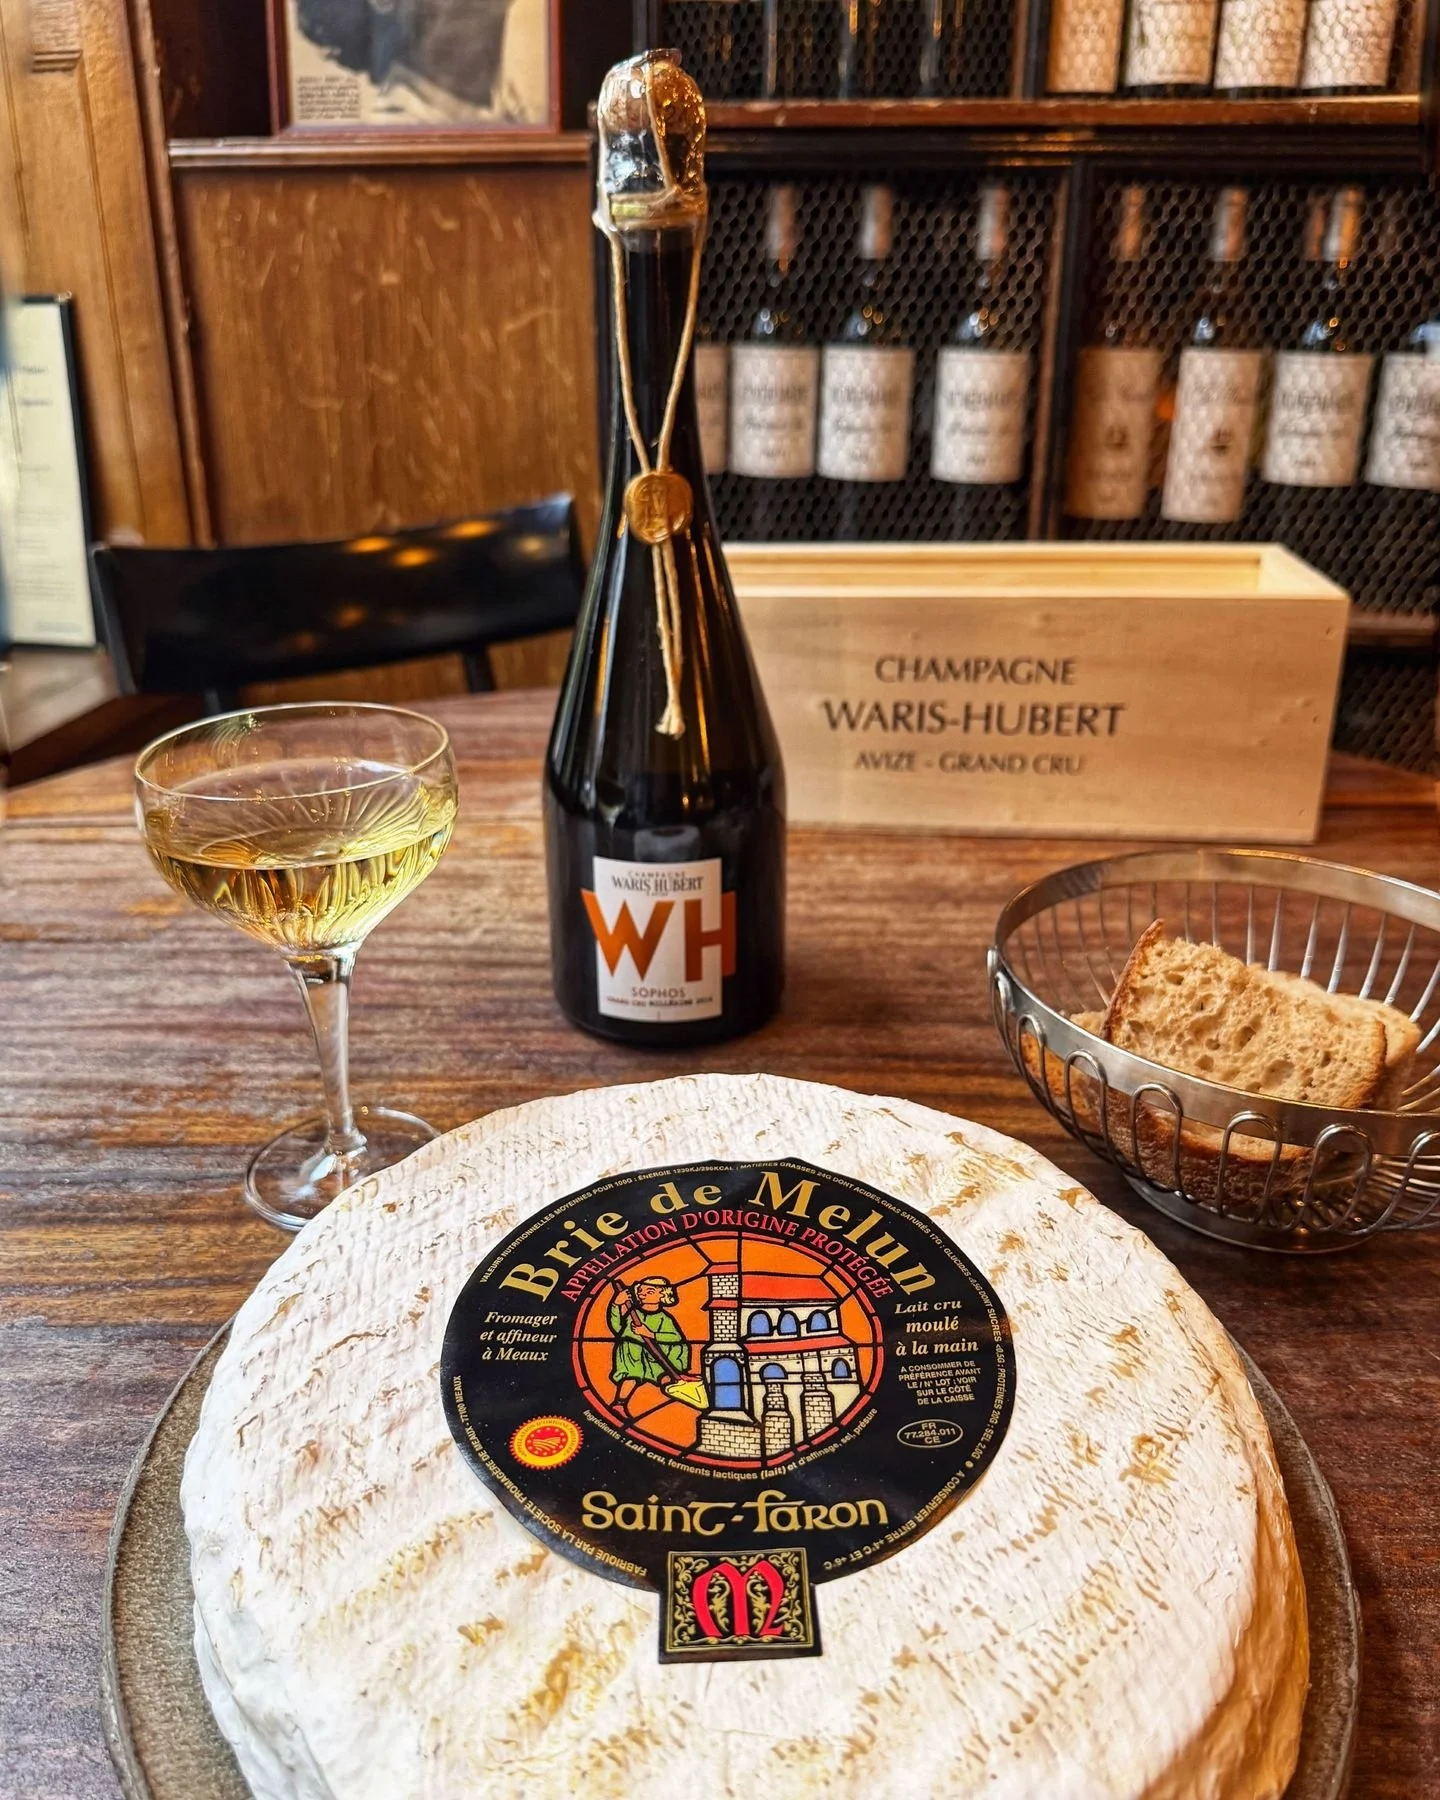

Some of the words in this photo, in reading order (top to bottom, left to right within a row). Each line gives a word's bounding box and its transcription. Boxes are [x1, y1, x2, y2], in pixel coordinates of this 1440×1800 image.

[874, 655, 1078, 686] CHAMPAGNE
[822, 699, 1128, 737] WARIS-HUBERT
[853, 751, 915, 773] AVIZE
[938, 752, 1027, 774] GRAND
[1032, 754, 1083, 776] CRU
[611, 876, 651, 892] WARIS
[654, 876, 703, 892] HUBERT
[631, 986, 686, 998] SOPHOS
[780, 1161, 816, 1175] GRASSES
[816, 1171, 831, 1180] 24G
[592, 1183, 614, 1195] POUR
[614, 1178, 633, 1188] 100G
[832, 1177, 854, 1189] DONT
[553, 1192, 592, 1215] MOYENNES
[881, 1200, 901, 1214] GRAS
[900, 1211, 931, 1234] SATURÉS
[499, 1211, 629, 1302] Brie
[650, 1181, 723, 1214] de
[748, 1171, 936, 1296] Melun
[501, 1213, 555, 1257] NUTRITIONNELLES
[929, 1233, 942, 1245] 17G
[560, 1217, 678, 1302] APPELLATION
[681, 1209, 800, 1236] D'ORIGINE
[800, 1226, 894, 1299] PROTÉGÉE
[943, 1248, 972, 1277] GLUCIDES
[480, 1256, 504, 1282] VALEURS
[895, 1301, 929, 1314] Lait
[934, 1300, 962, 1311] cru
[978, 1290, 994, 1307] DONT
[484, 1311, 558, 1328] Fromager
[906, 1315, 959, 1333] moulé
[988, 1308, 1002, 1342] SUCRES
[480, 1330, 495, 1340] et
[496, 1329, 557, 1344] affineur
[481, 1346, 493, 1360] à
[495, 1347, 549, 1361] Meaux
[895, 1341, 907, 1356] à
[912, 1341, 929, 1355] la
[934, 1338, 979, 1354] main
[898, 1369, 954, 1381] PRÉFÉRENCE
[955, 1367, 982, 1376] AVANT
[901, 1365, 908, 1373] A
[908, 1361, 963, 1372] CONSOMMER
[453, 1375, 464, 1403] MEAUX
[935, 1378, 951, 1386] LOT
[956, 1376, 977, 1384] VOIR
[916, 1388, 934, 1397] SUR
[936, 1387, 948, 1395] LE
[948, 1384, 972, 1394] CÔTÉ
[931, 1396, 943, 1404] LA
[944, 1393, 976, 1403] CAISSE
[457, 1403, 470, 1422] 77100
[904, 1428, 957, 1439] 77.284.011
[921, 1422, 937, 1430] FR
[981, 1427, 994, 1442] SEL
[465, 1425, 483, 1452] MEAUX
[583, 1409, 621, 1440] Ingrédients
[625, 1440, 647, 1454] Lait
[646, 1452, 666, 1465] cru,
[667, 1458, 711, 1476] ferments
[712, 1469, 758, 1481] lactiques
[760, 1466, 787, 1480] (lait)
[787, 1462, 798, 1471] et
[798, 1443, 843, 1466] d'affinage,
[841, 1432, 856, 1444] sel,
[853, 1408, 878, 1434] présure
[924, 1436, 940, 1444] CE
[478, 1449, 490, 1462] DE
[485, 1459, 527, 1503] FROMAGÈRE
[914, 1476, 960, 1523] CONSERVER
[524, 1500, 562, 1534] SOCIÉTÉ
[561, 1529, 576, 1543] LA
[884, 1519, 917, 1543] ENTRE
[574, 1537, 595, 1555] PAR
[595, 1549, 648, 1577] FABRIQUÉ
[849, 1551, 863, 1562] ET
